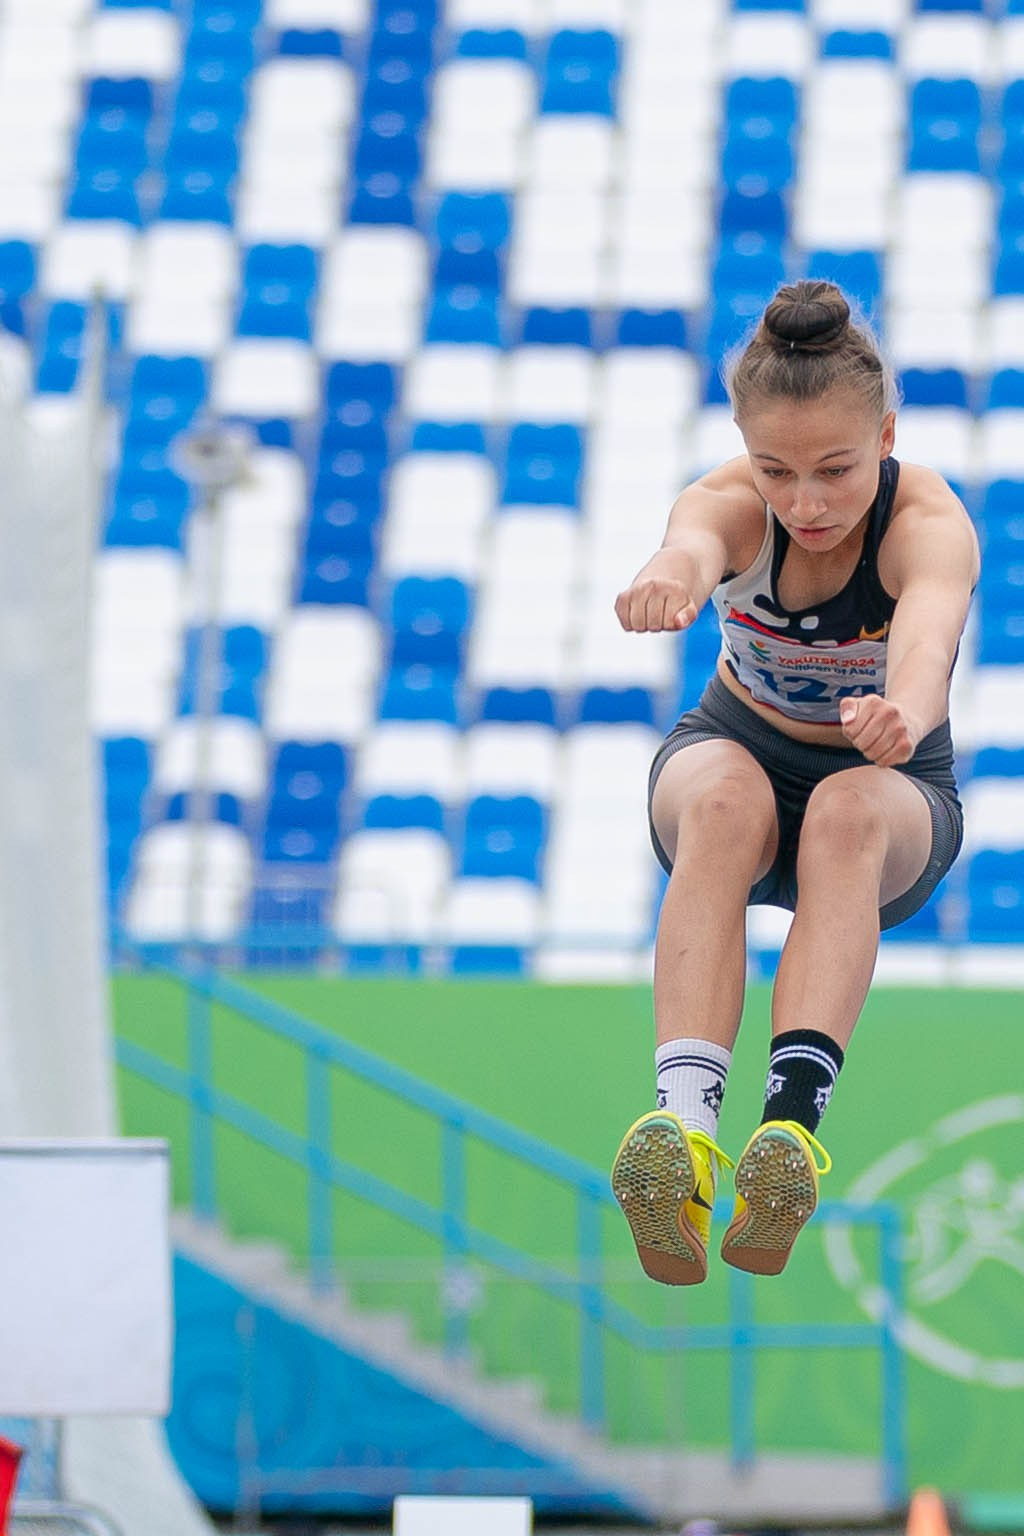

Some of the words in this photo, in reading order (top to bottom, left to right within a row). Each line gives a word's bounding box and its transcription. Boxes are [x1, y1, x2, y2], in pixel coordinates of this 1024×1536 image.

[777, 655, 839, 665] YAKUTSK
[841, 656, 876, 668] 2024
[848, 667, 877, 677] Asia
